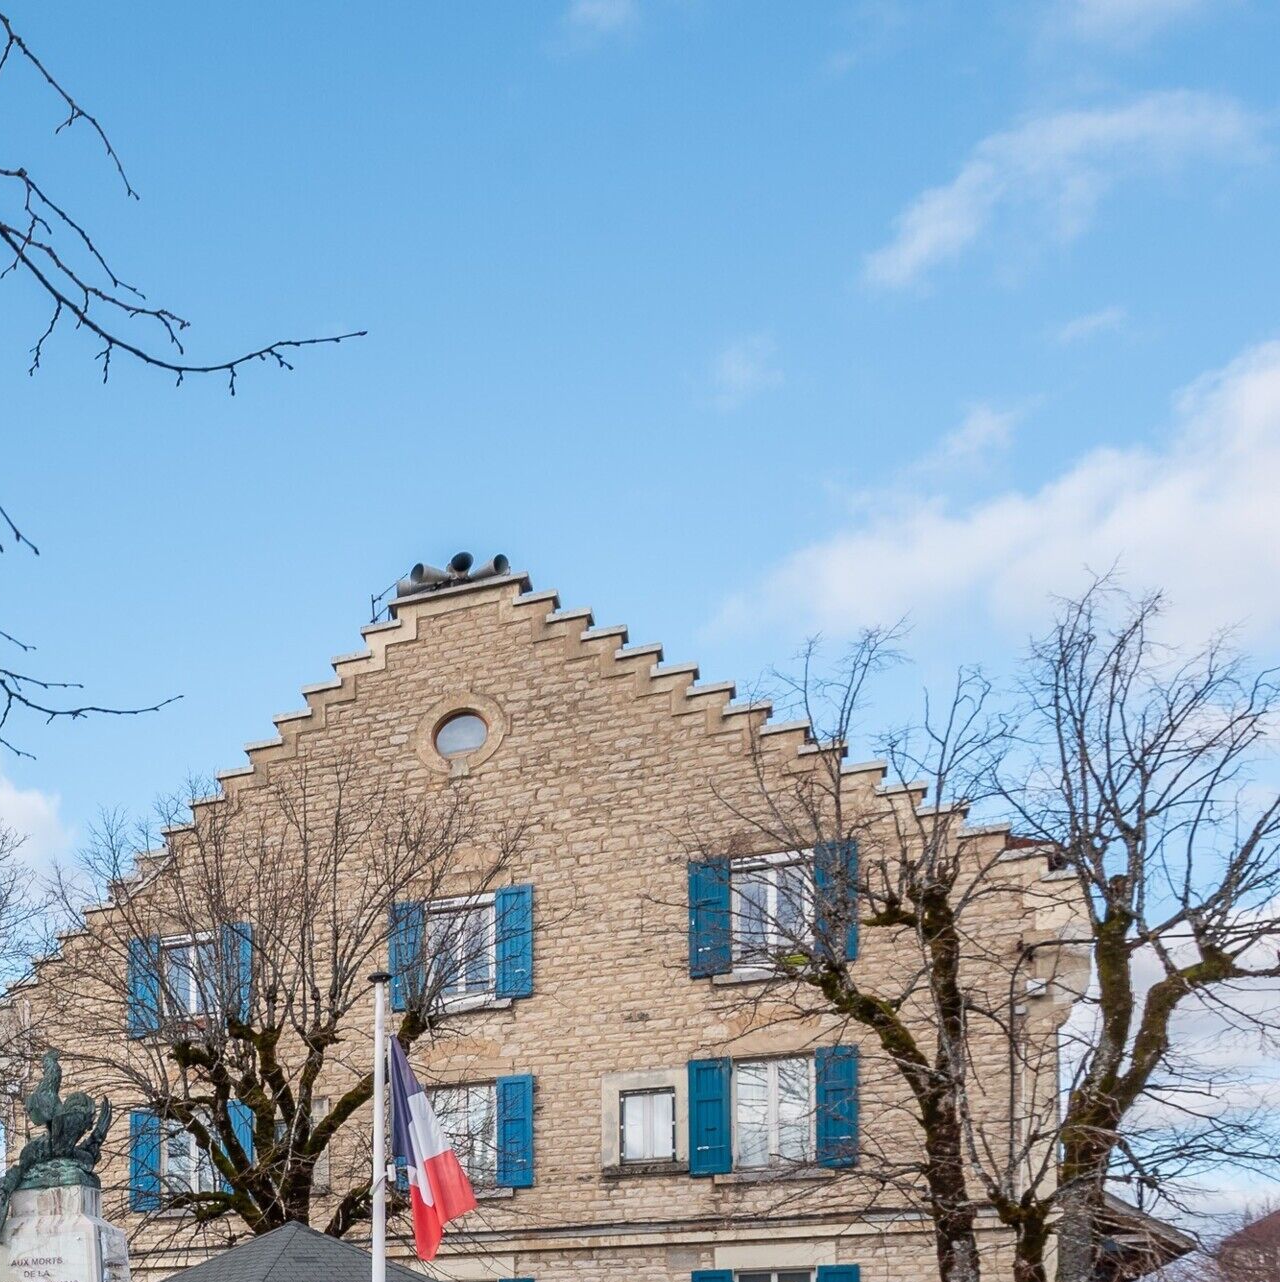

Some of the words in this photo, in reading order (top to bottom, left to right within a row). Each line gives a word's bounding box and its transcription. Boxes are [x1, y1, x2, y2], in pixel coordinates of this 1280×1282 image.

[11, 1259, 29, 1267] AUX
[31, 1257, 63, 1266] MORTS
[24, 1270, 35, 1278] DE
